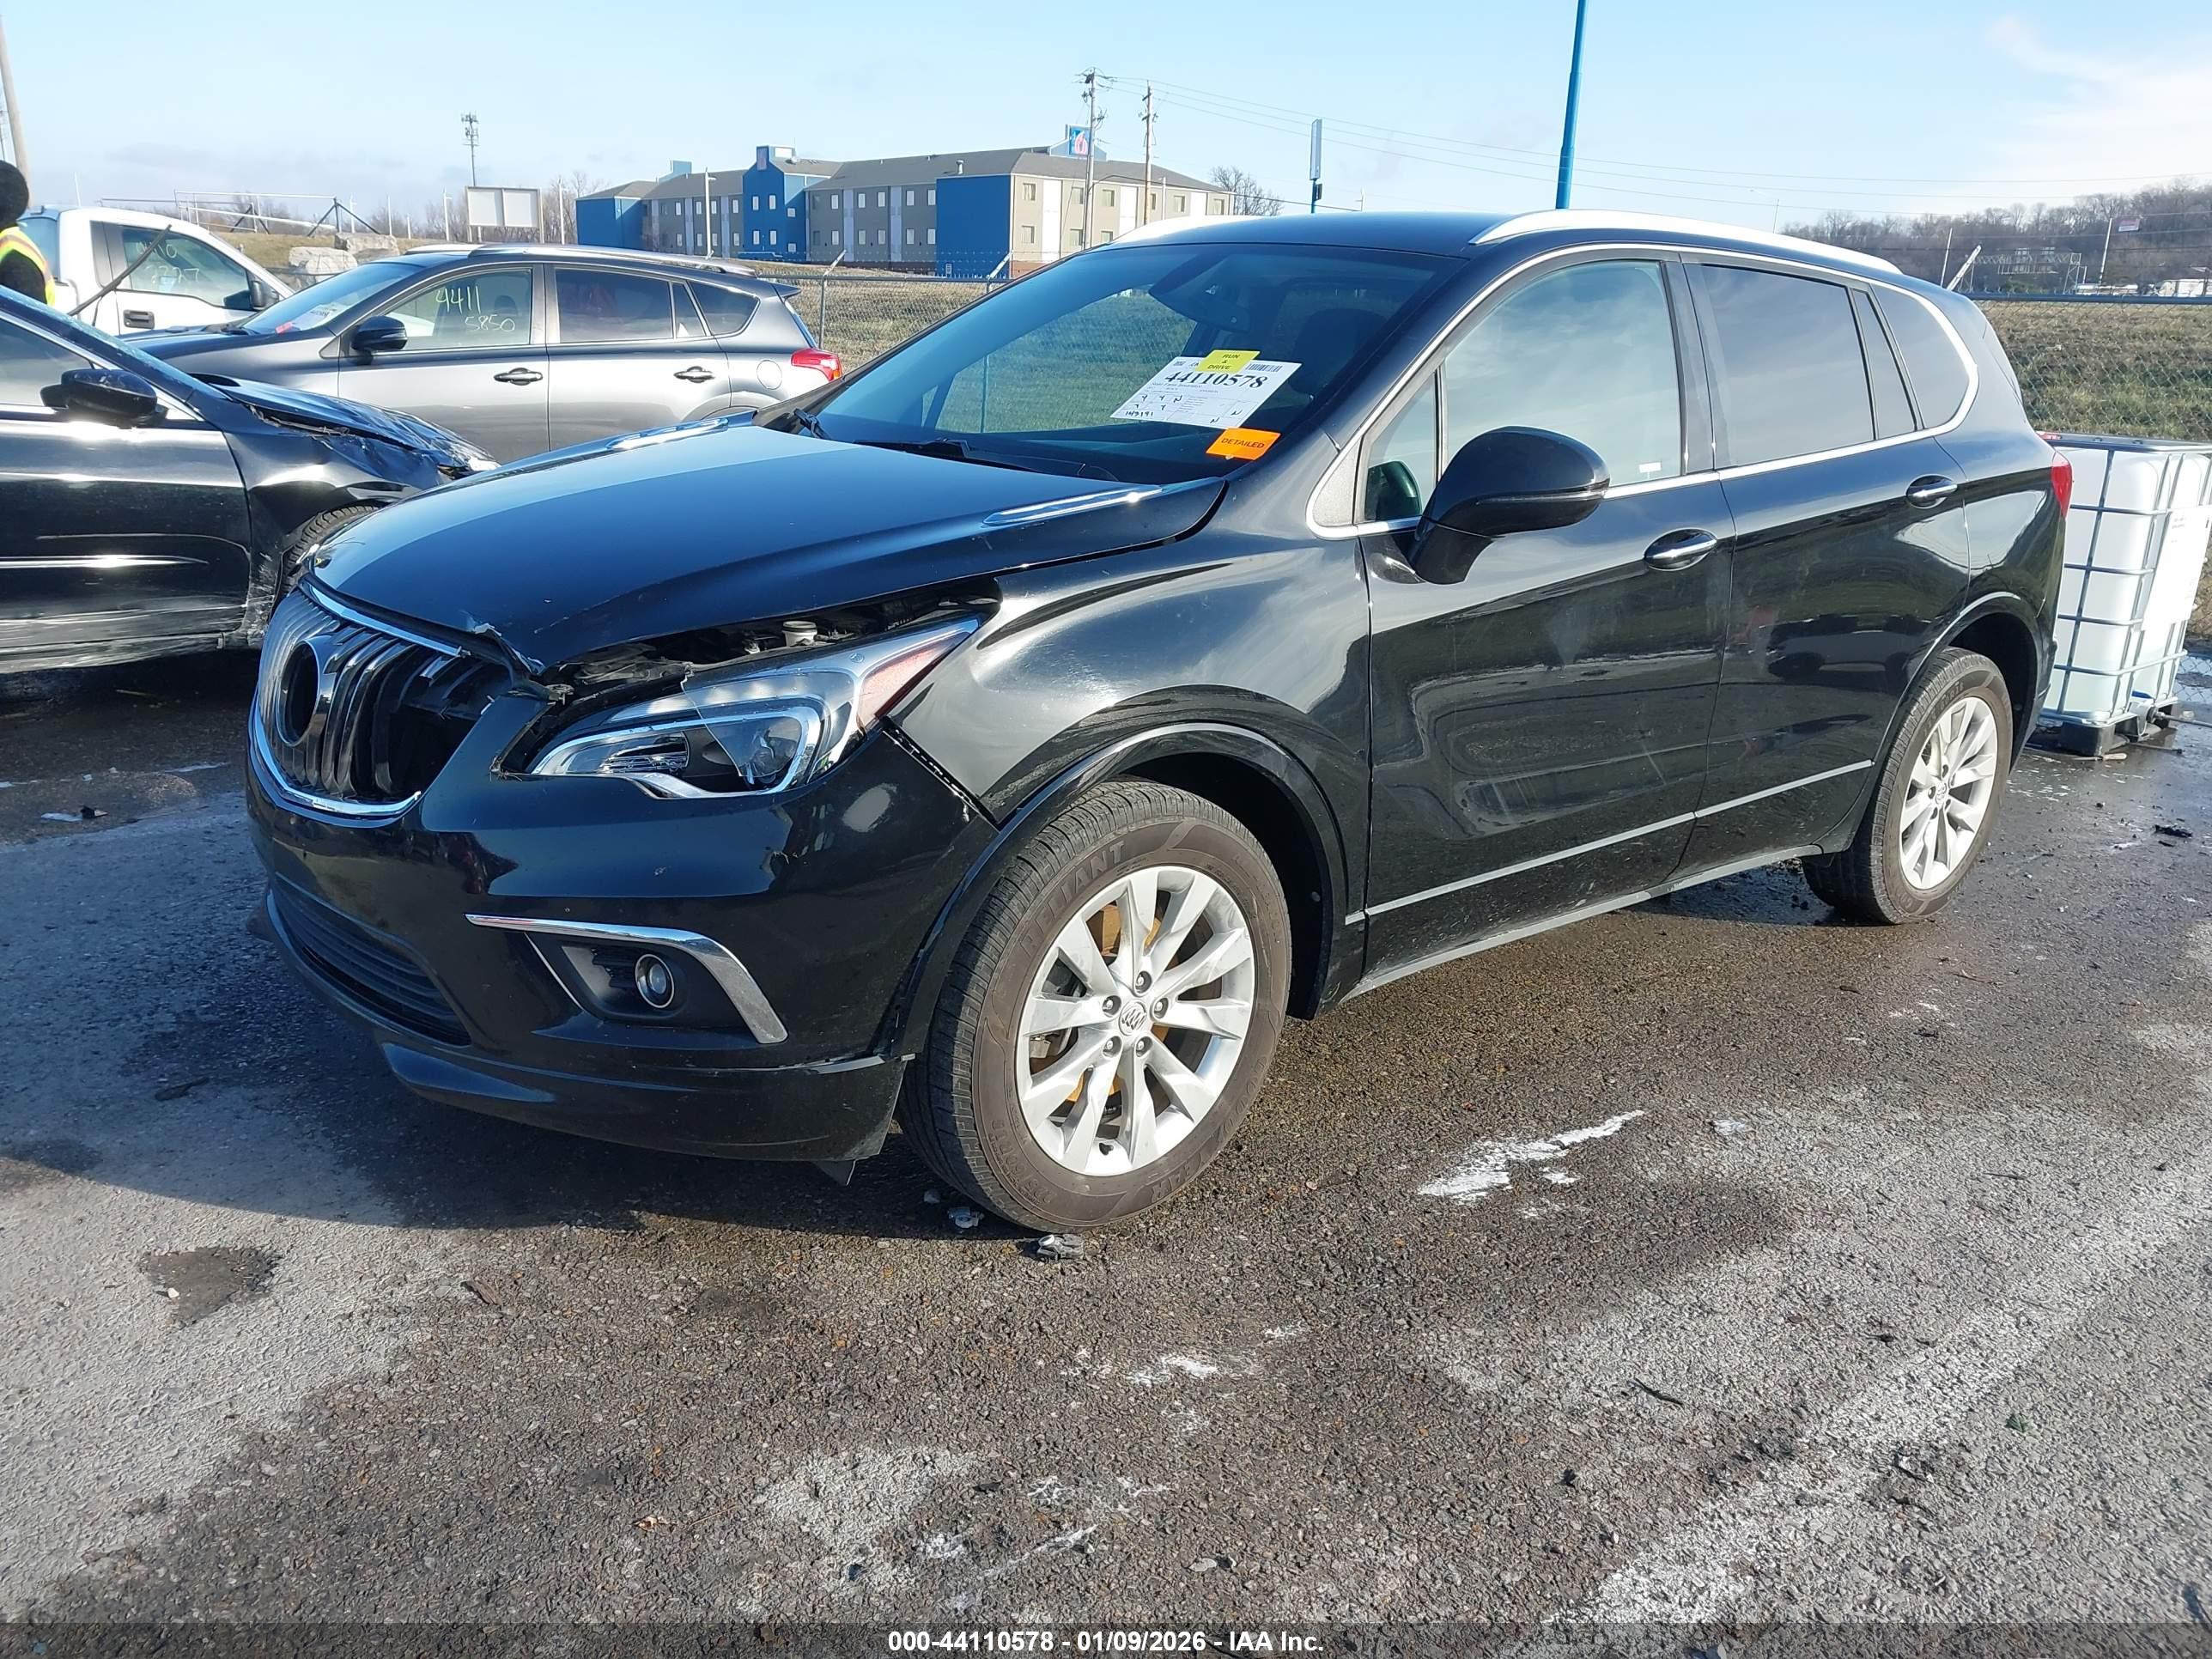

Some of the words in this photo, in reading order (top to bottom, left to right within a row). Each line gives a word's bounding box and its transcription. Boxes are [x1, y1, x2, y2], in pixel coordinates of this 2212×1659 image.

[435, 286, 482, 314] 4411
[465, 314, 516, 332] 5850
[1164, 371, 1268, 389] 44110578
[1220, 437, 1265, 449] DETAILED
[1019, 840, 1125, 958] RELIANT
